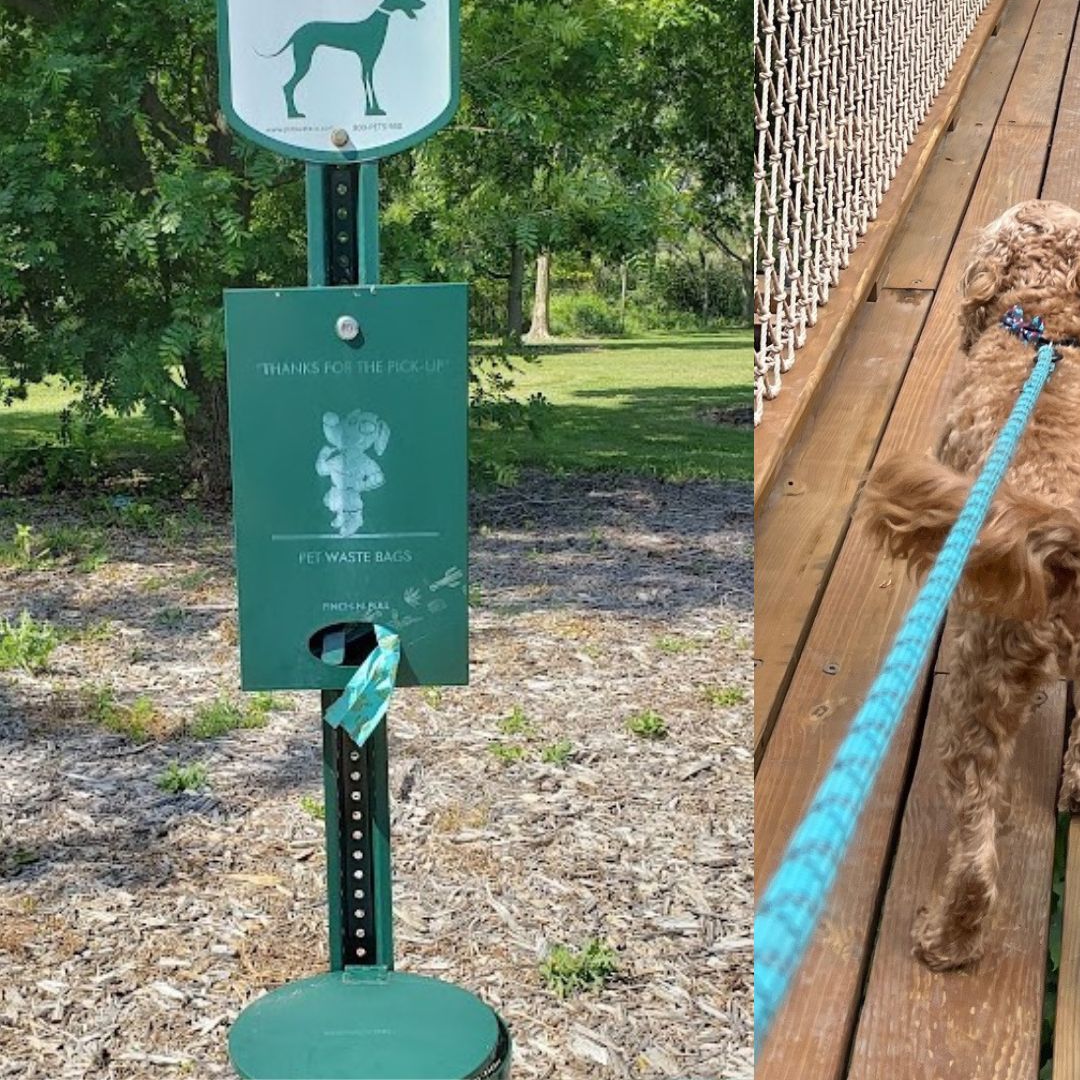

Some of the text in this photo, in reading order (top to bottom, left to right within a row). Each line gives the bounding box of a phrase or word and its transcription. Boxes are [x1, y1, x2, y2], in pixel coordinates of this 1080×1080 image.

[324, 361, 351, 374] FOR
[357, 360, 383, 374] THE
[299, 550, 413, 564] PET WASTE BAGS
